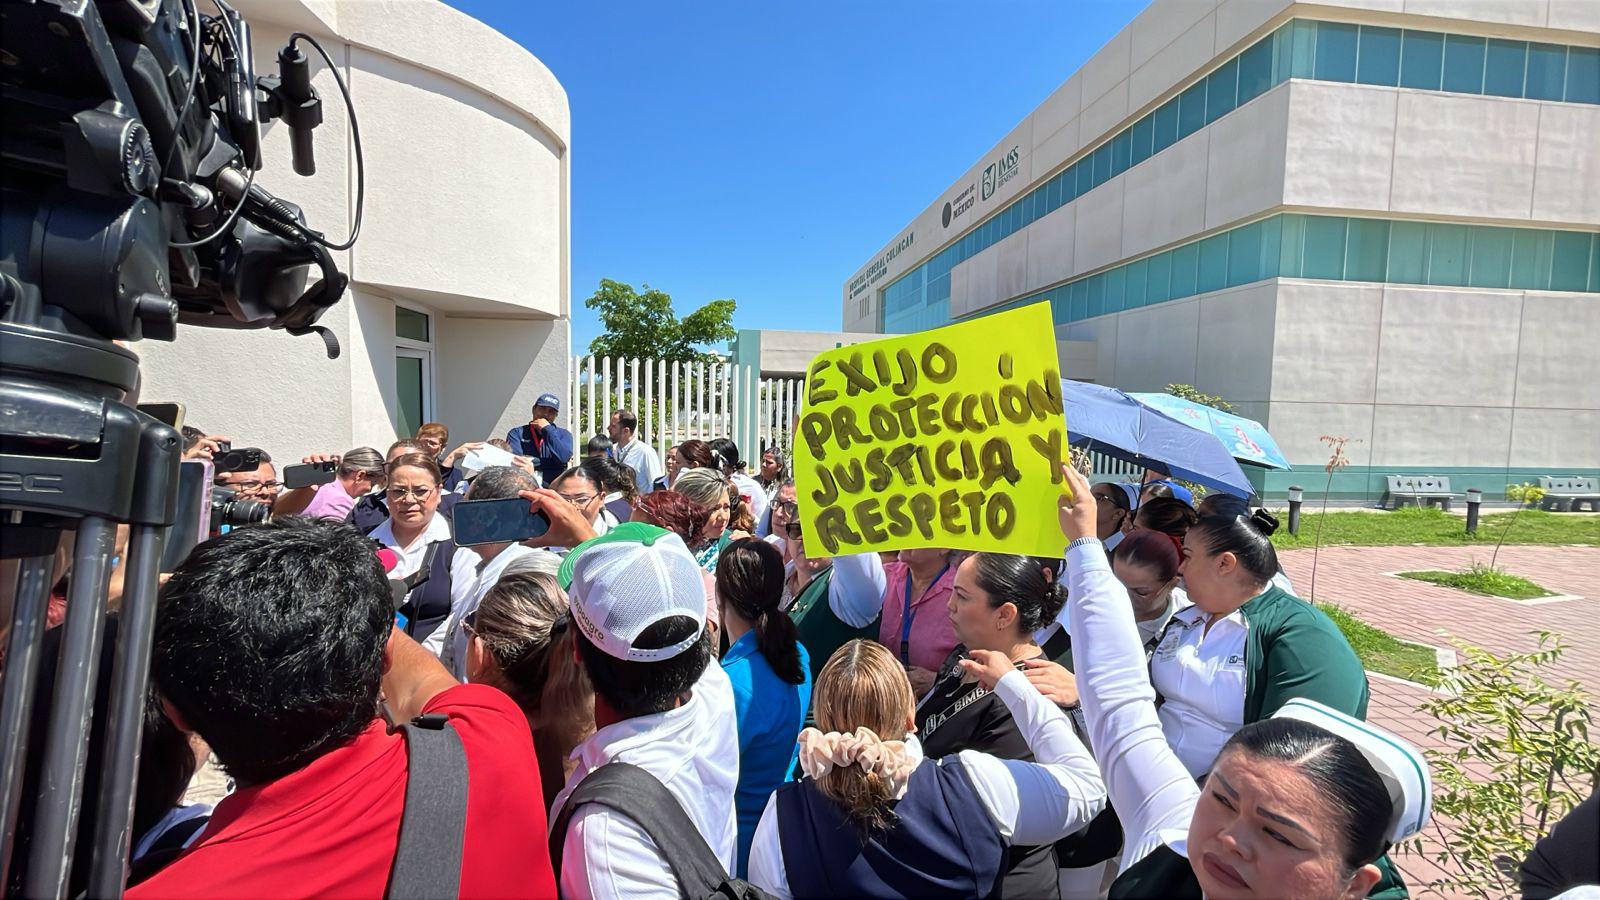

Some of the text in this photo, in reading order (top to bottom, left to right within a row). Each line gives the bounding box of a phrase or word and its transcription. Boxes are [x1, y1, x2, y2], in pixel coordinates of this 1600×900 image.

[998, 145, 1019, 177] IMSS
[809, 342, 958, 406] EXIJO
[812, 428, 1064, 507] JUSTICIA Y
[814, 488, 1016, 554] RESPETO
[954, 687, 989, 712] BIMB
